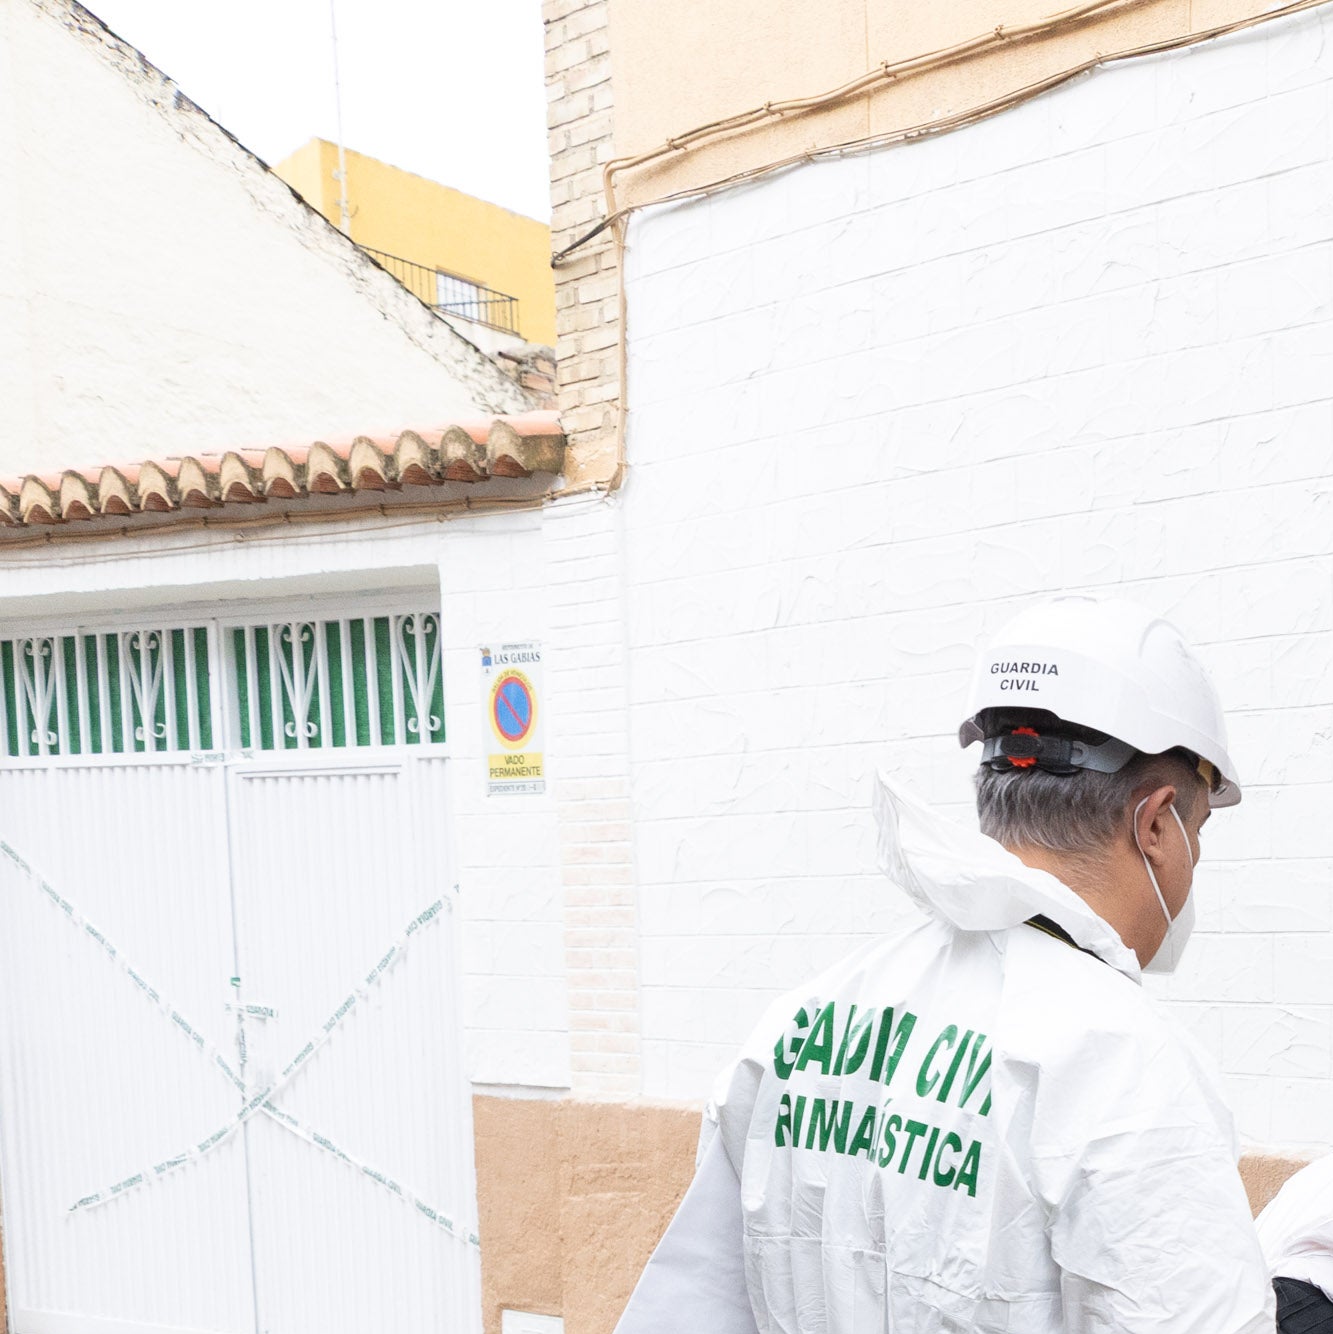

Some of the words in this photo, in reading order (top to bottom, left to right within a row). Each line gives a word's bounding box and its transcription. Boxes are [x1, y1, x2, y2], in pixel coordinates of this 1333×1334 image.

[494, 653, 509, 665] LAS
[510, 651, 541, 664] GABIAS
[990, 662, 1059, 676] GUARDIA
[1000, 679, 1040, 692] CIVIL
[503, 754, 525, 765] VADO
[489, 766, 541, 779] PERMANENTE
